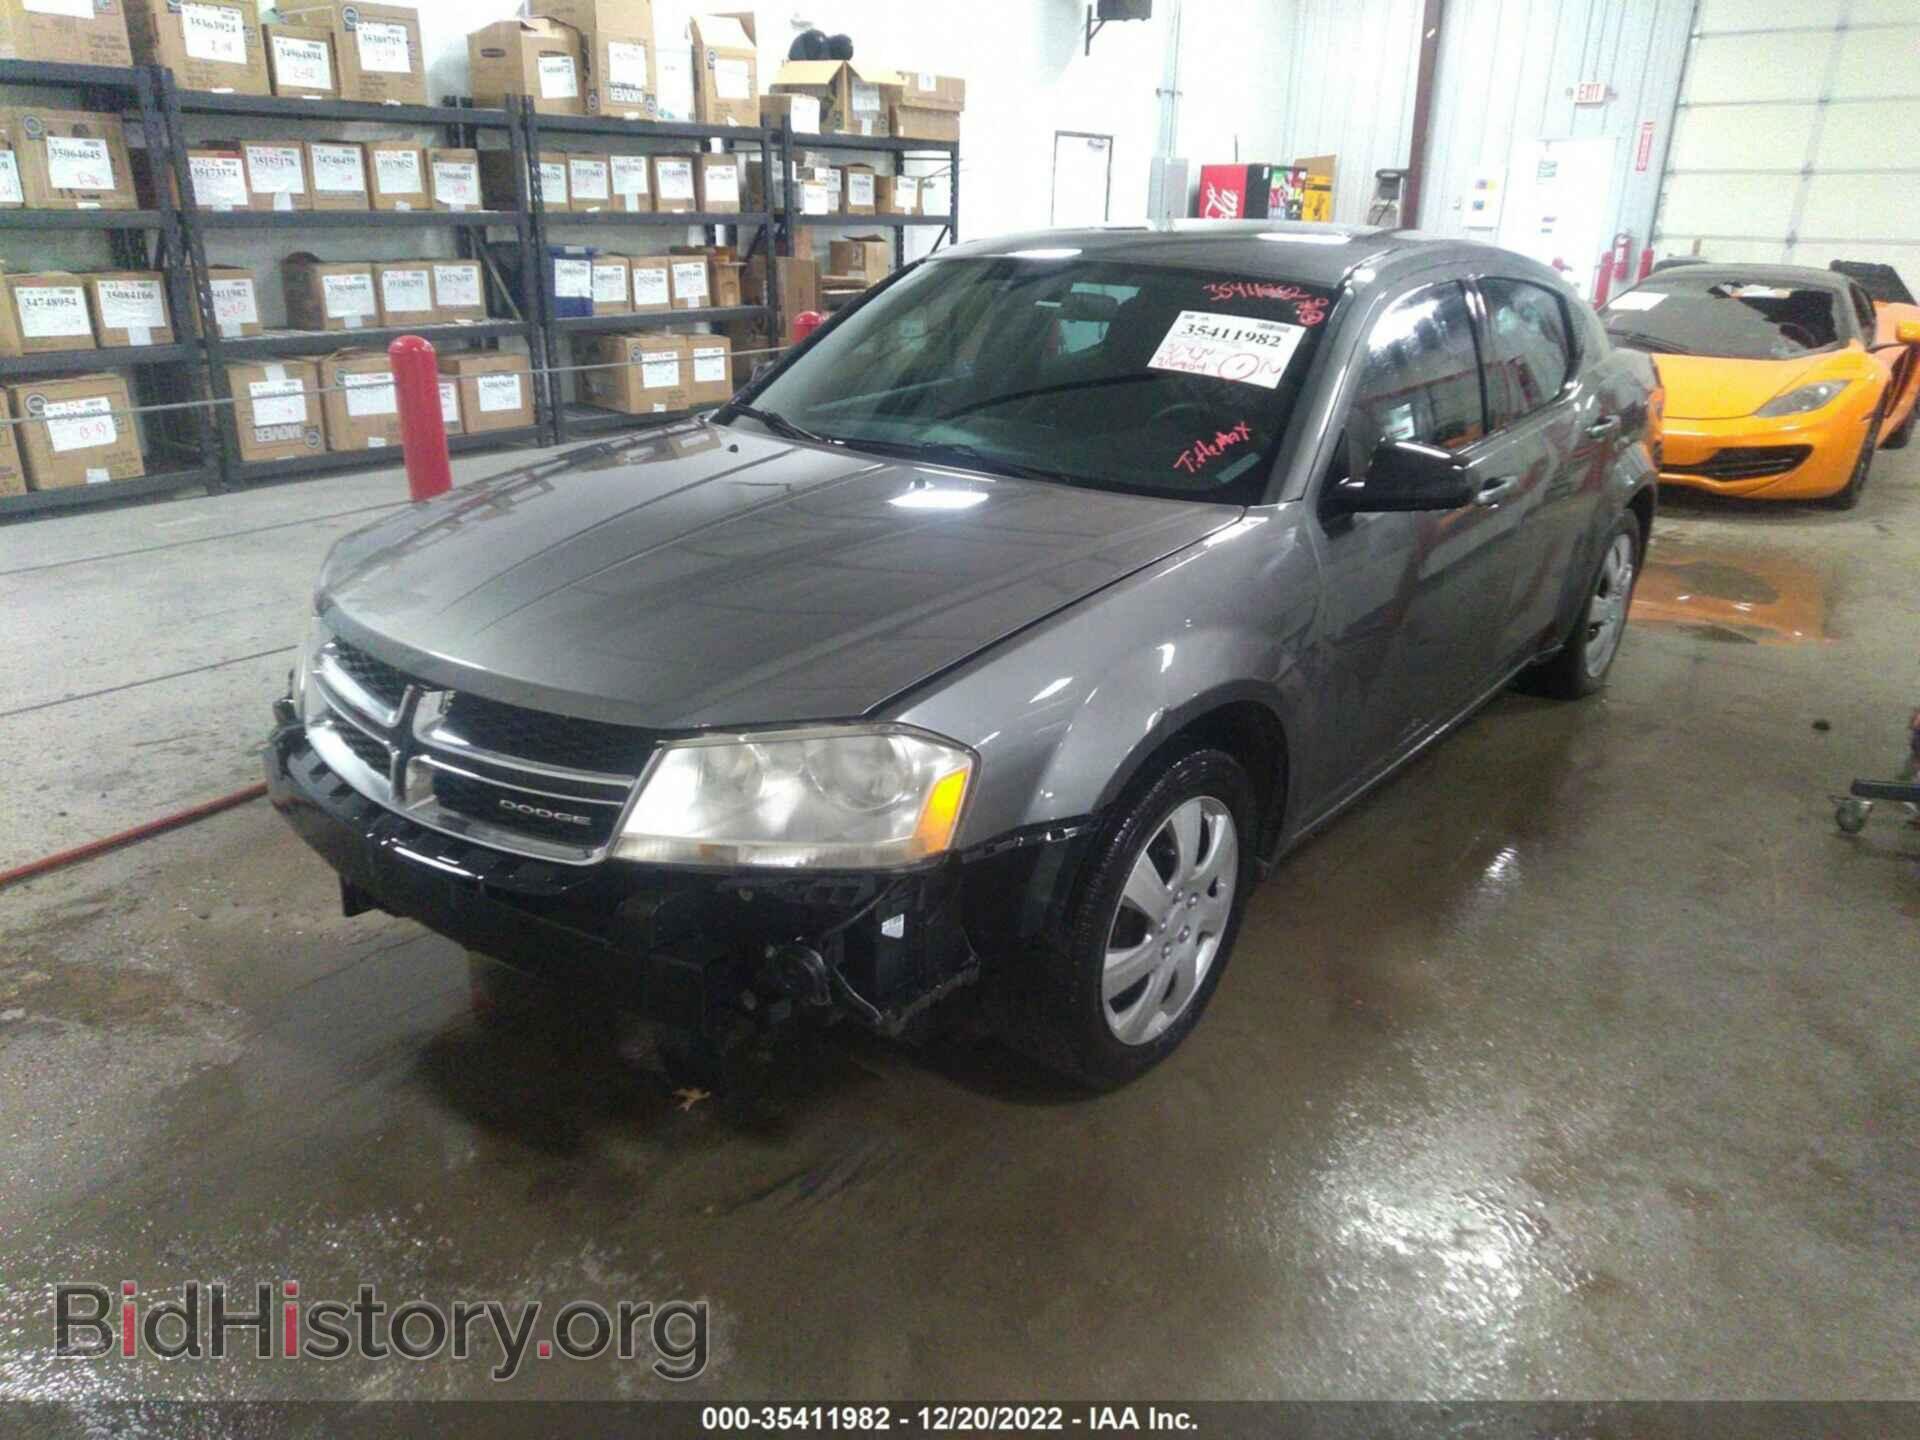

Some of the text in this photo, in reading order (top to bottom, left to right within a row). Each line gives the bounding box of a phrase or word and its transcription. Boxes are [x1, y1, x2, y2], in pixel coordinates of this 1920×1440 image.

[1578, 83, 1601, 101] EXIT
[1181, 323, 1282, 348] 35411982
[499, 799, 593, 826] DODGE
